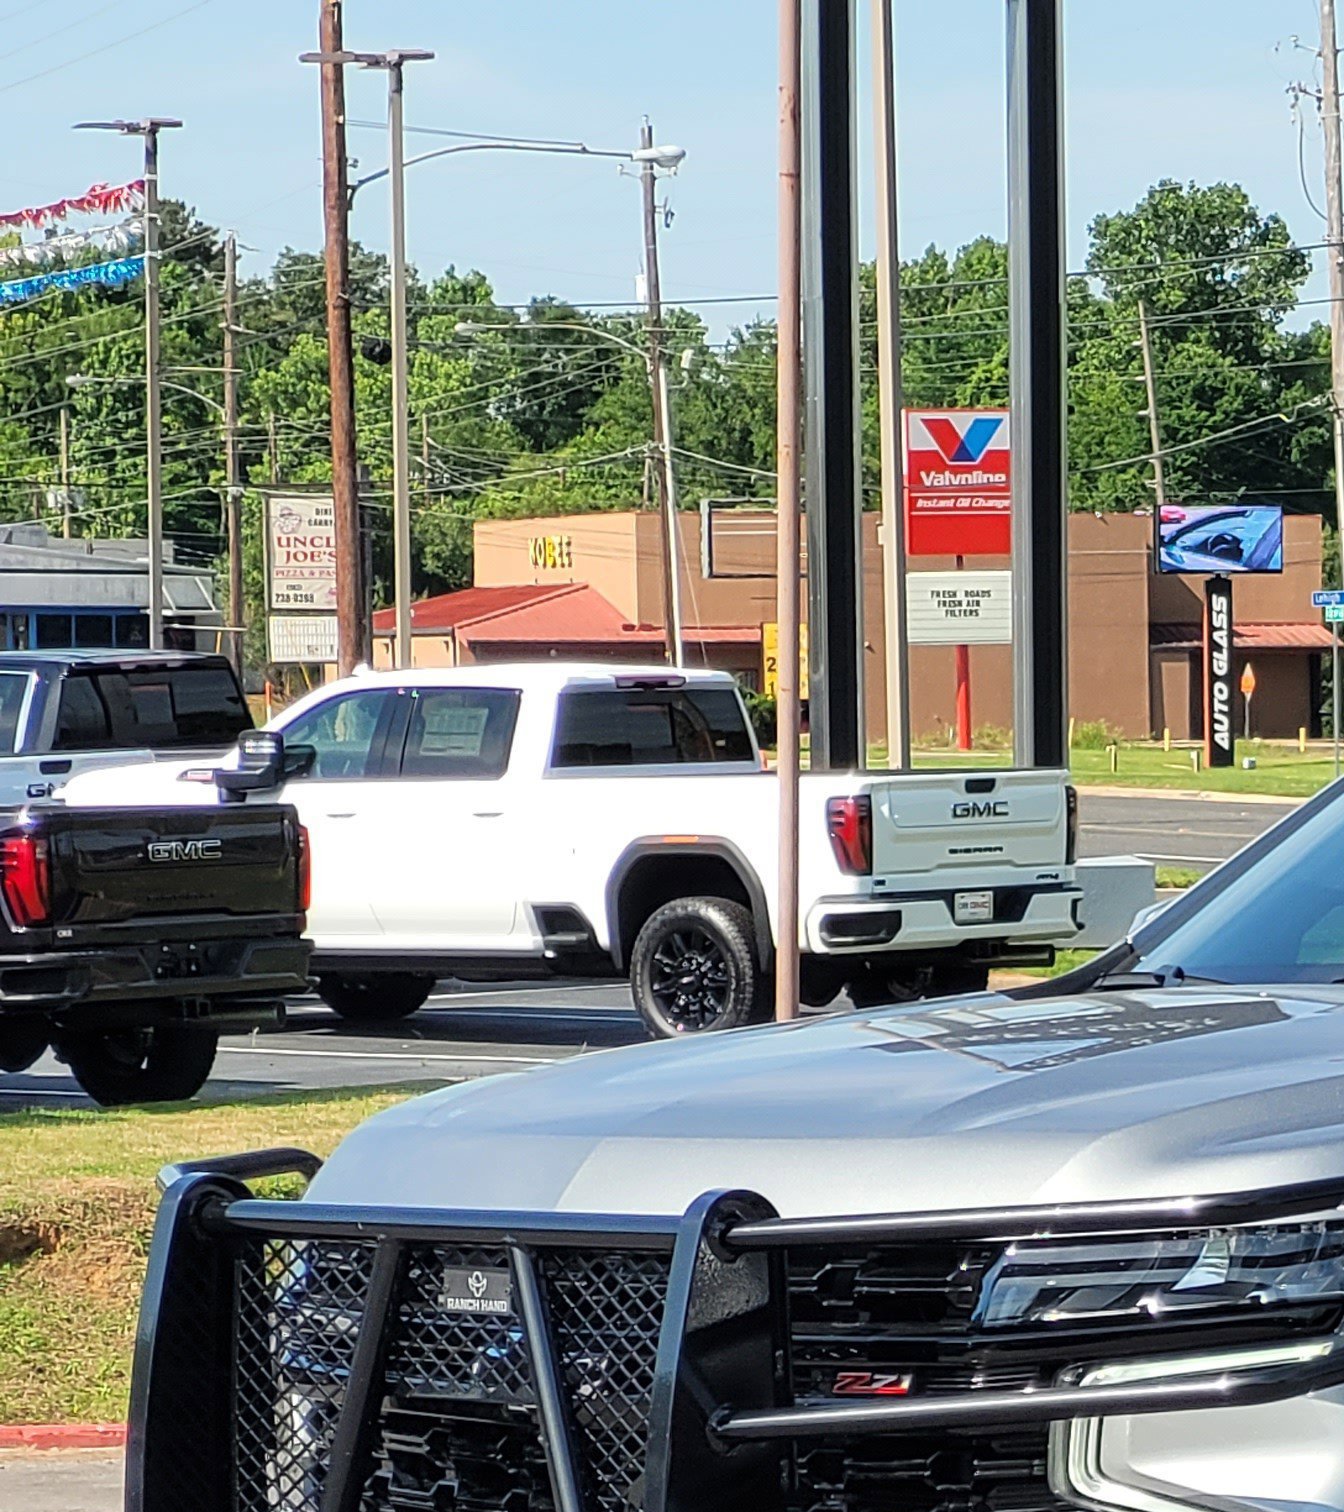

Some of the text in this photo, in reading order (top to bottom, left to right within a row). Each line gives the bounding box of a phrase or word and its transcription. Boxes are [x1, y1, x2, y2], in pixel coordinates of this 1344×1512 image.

[916, 497, 1011, 509] Instant Oil Change
[276, 535, 336, 549] UNCL
[275, 569, 305, 577] PIZZA
[930, 590, 991, 599] FRESH ROADS
[937, 599, 981, 608] FRESH AIR
[945, 609, 979, 618] FILTERS
[1212, 593, 1231, 751] AUTO GLASS
[953, 801, 1009, 818] GMC
[149, 840, 222, 862] GMC
[948, 846, 1003, 855] SIERRA
[446, 1297, 507, 1312] RANCH HAND
[832, 1372, 913, 1395] Z71
